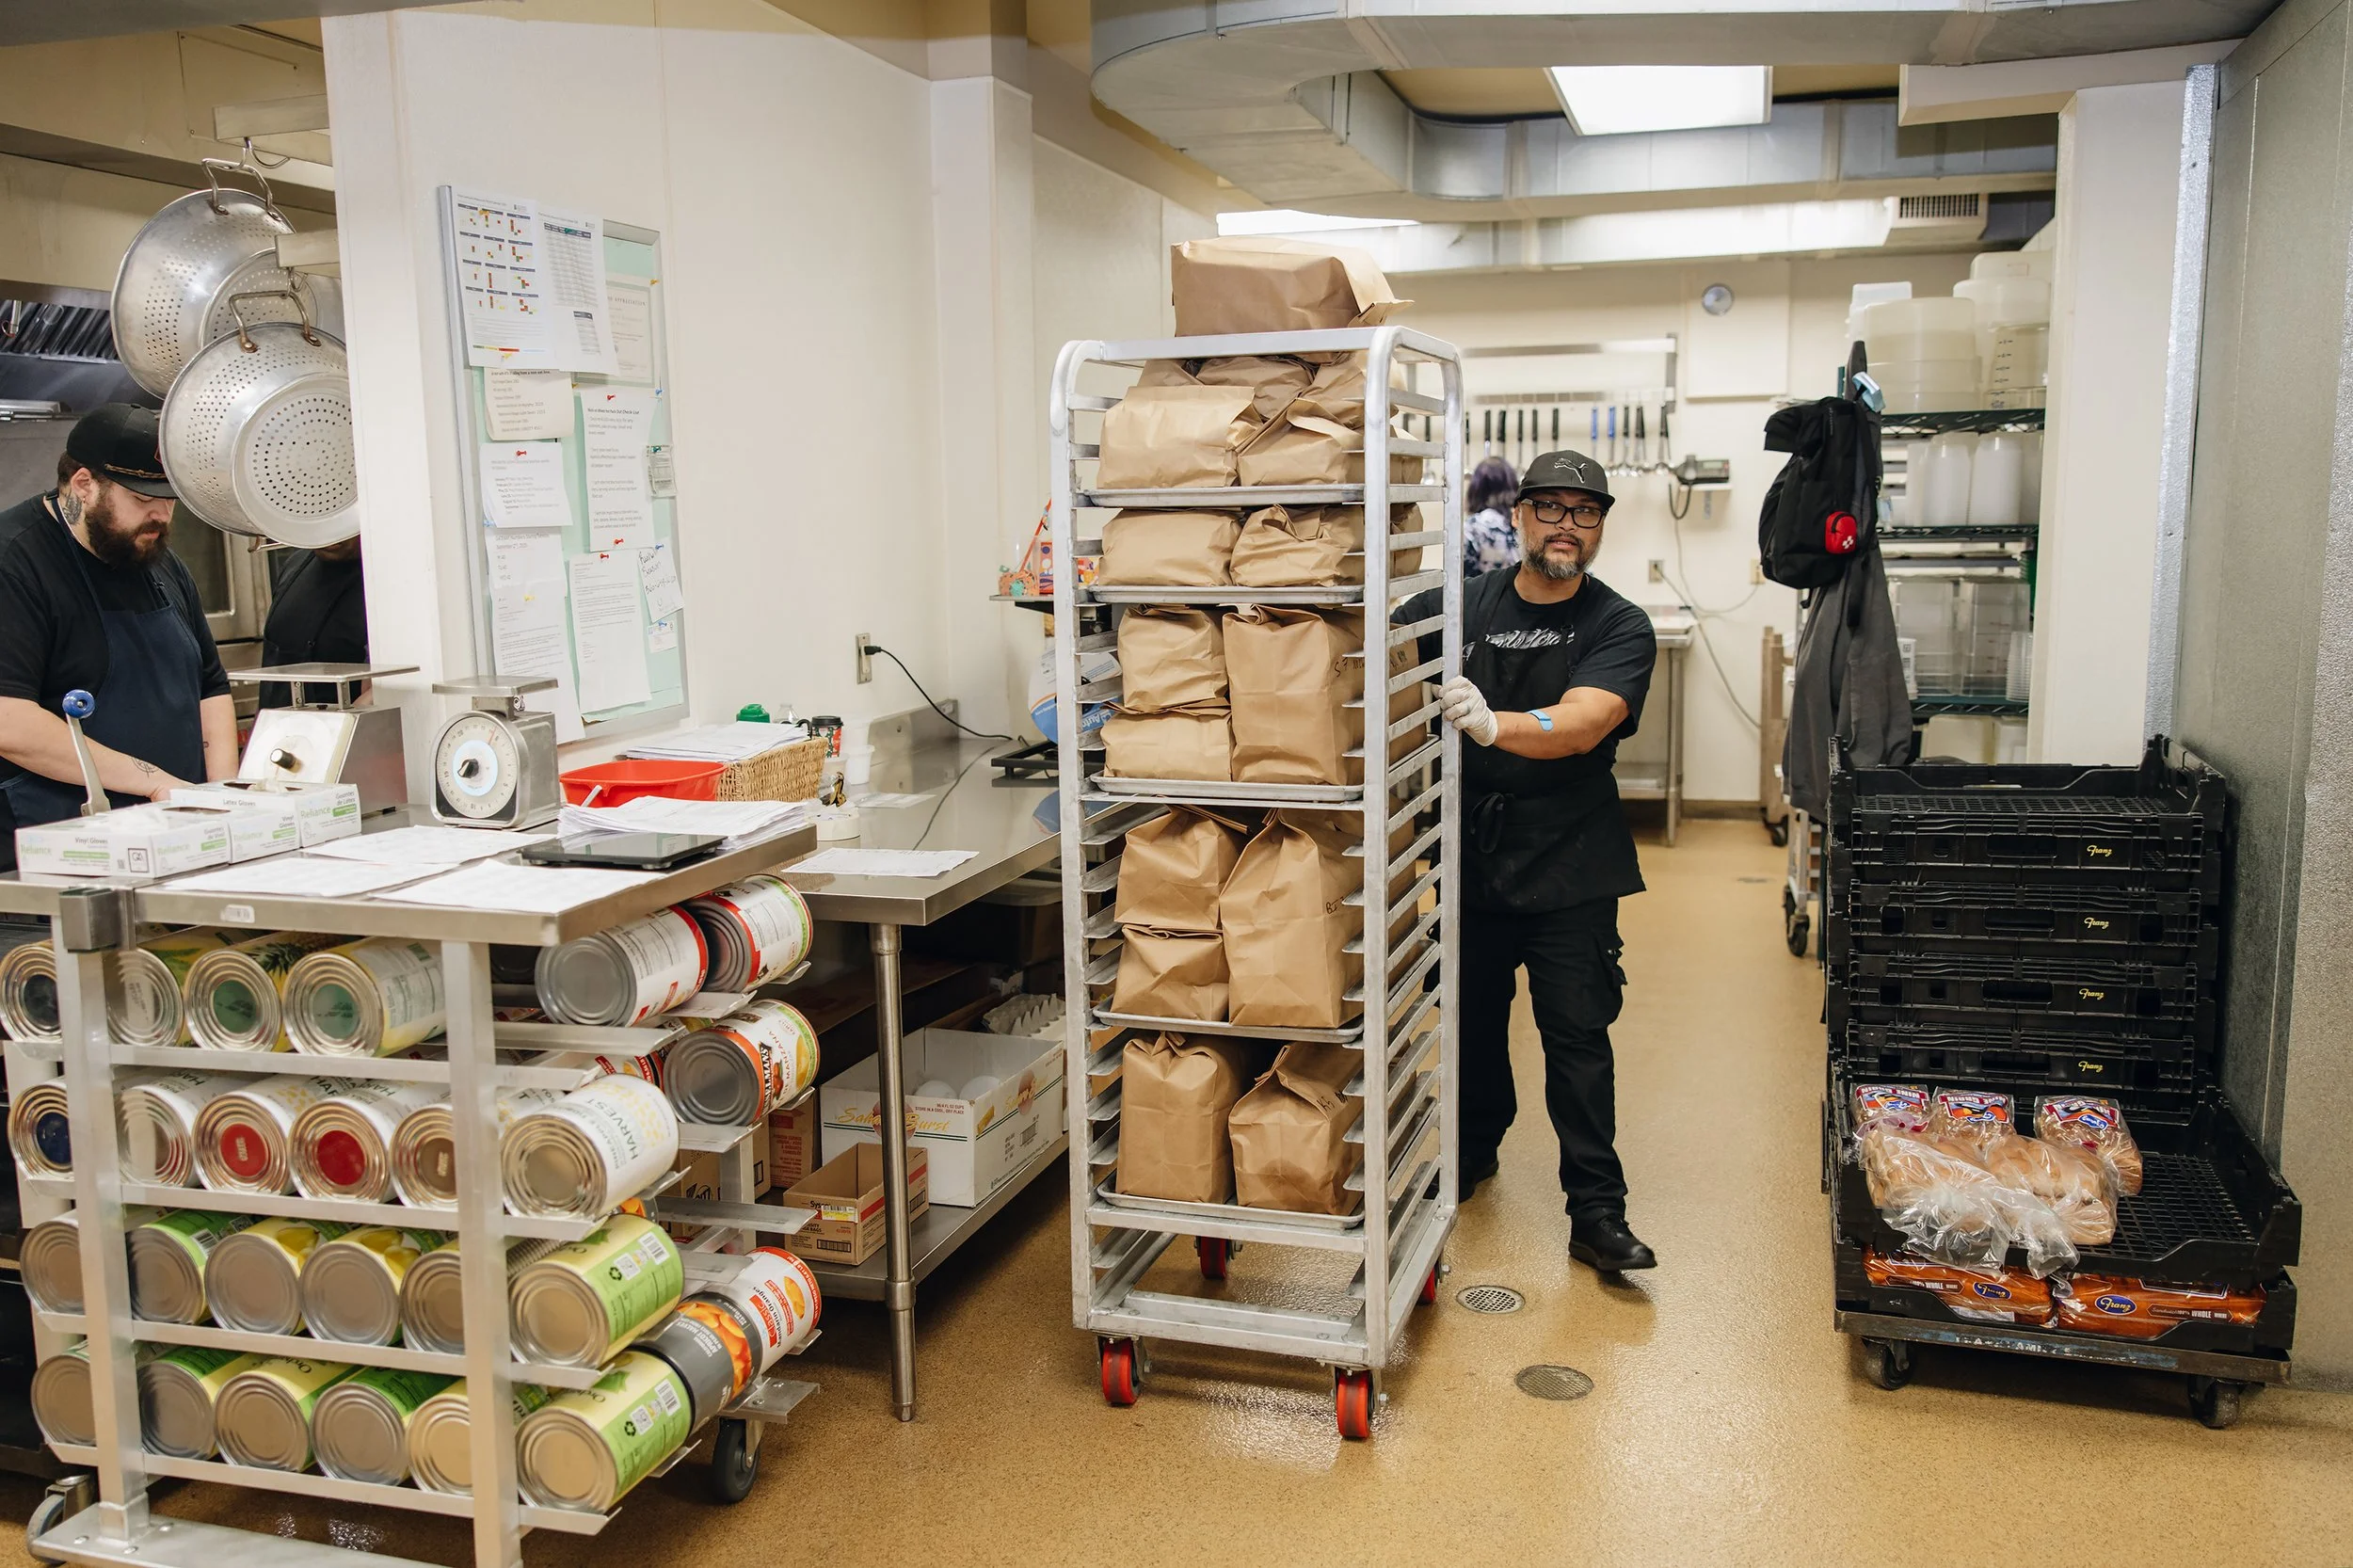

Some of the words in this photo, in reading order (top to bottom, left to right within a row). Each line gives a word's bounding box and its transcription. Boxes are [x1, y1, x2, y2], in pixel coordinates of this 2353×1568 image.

[300, 808, 331, 819] Reliance
[75, 837, 89, 845] Vinyl
[2087, 844, 2112, 857] Franz
[2083, 917, 2109, 930] Franz
[2078, 987, 2105, 1000] Franz
[2077, 1060, 2104, 1073] Franz
[1900, 1089, 1921, 1098] NINE
[586, 1097, 639, 1160] HARVEST
[1926, 1282, 1944, 1290] WHOLE
[753, 1287, 775, 1312] Oranges
[2100, 1297, 2131, 1312] Franz
[757, 1303, 776, 1337] Classic
[2191, 1310, 2211, 1319] WHOLE
[773, 1311, 782, 1348] Mandarin
[698, 1331, 719, 1353] APRICOT
